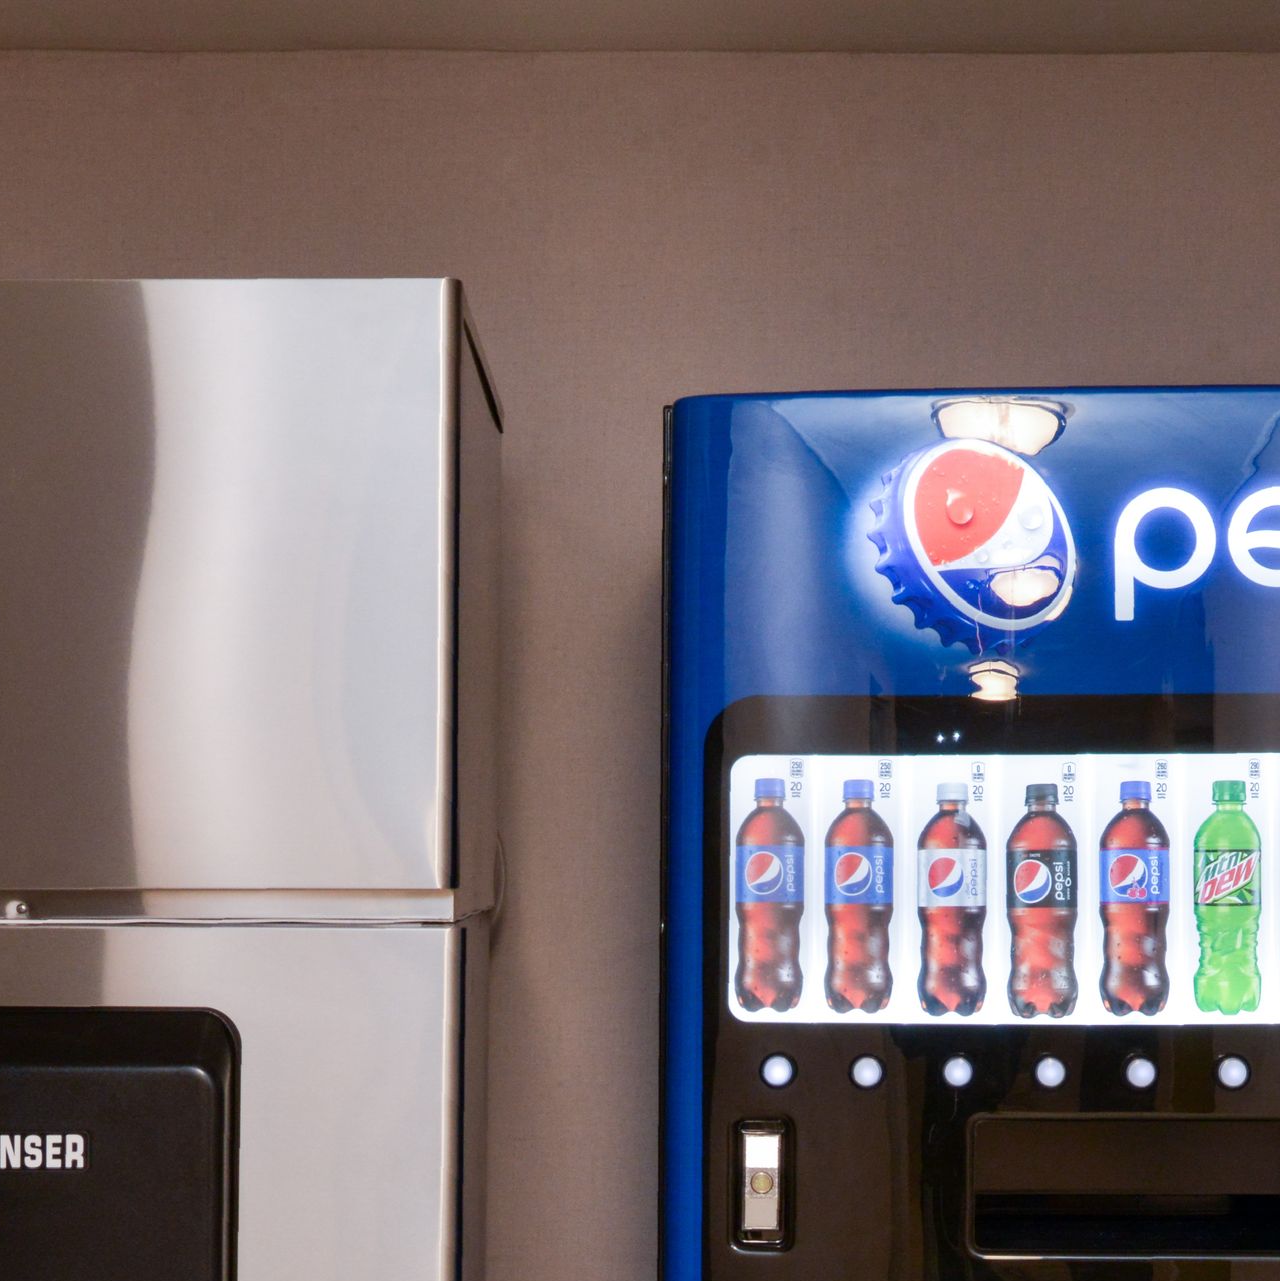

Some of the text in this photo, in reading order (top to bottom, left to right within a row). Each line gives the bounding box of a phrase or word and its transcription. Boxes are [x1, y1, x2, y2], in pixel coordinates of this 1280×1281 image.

[790, 781, 802, 791] 20
[880, 782, 891, 792] 20
[973, 785, 983, 794] 20
[1063, 785, 1074, 795] 20
[1156, 782, 1167, 792] 20
[1250, 782, 1259, 791] 20
[785, 854, 795, 892] pepsi
[874, 855, 884, 893] pepsi
[969, 859, 978, 897] pepsi
[1149, 856, 1160, 895] pepsi
[1053, 861, 1065, 900] pepsi
